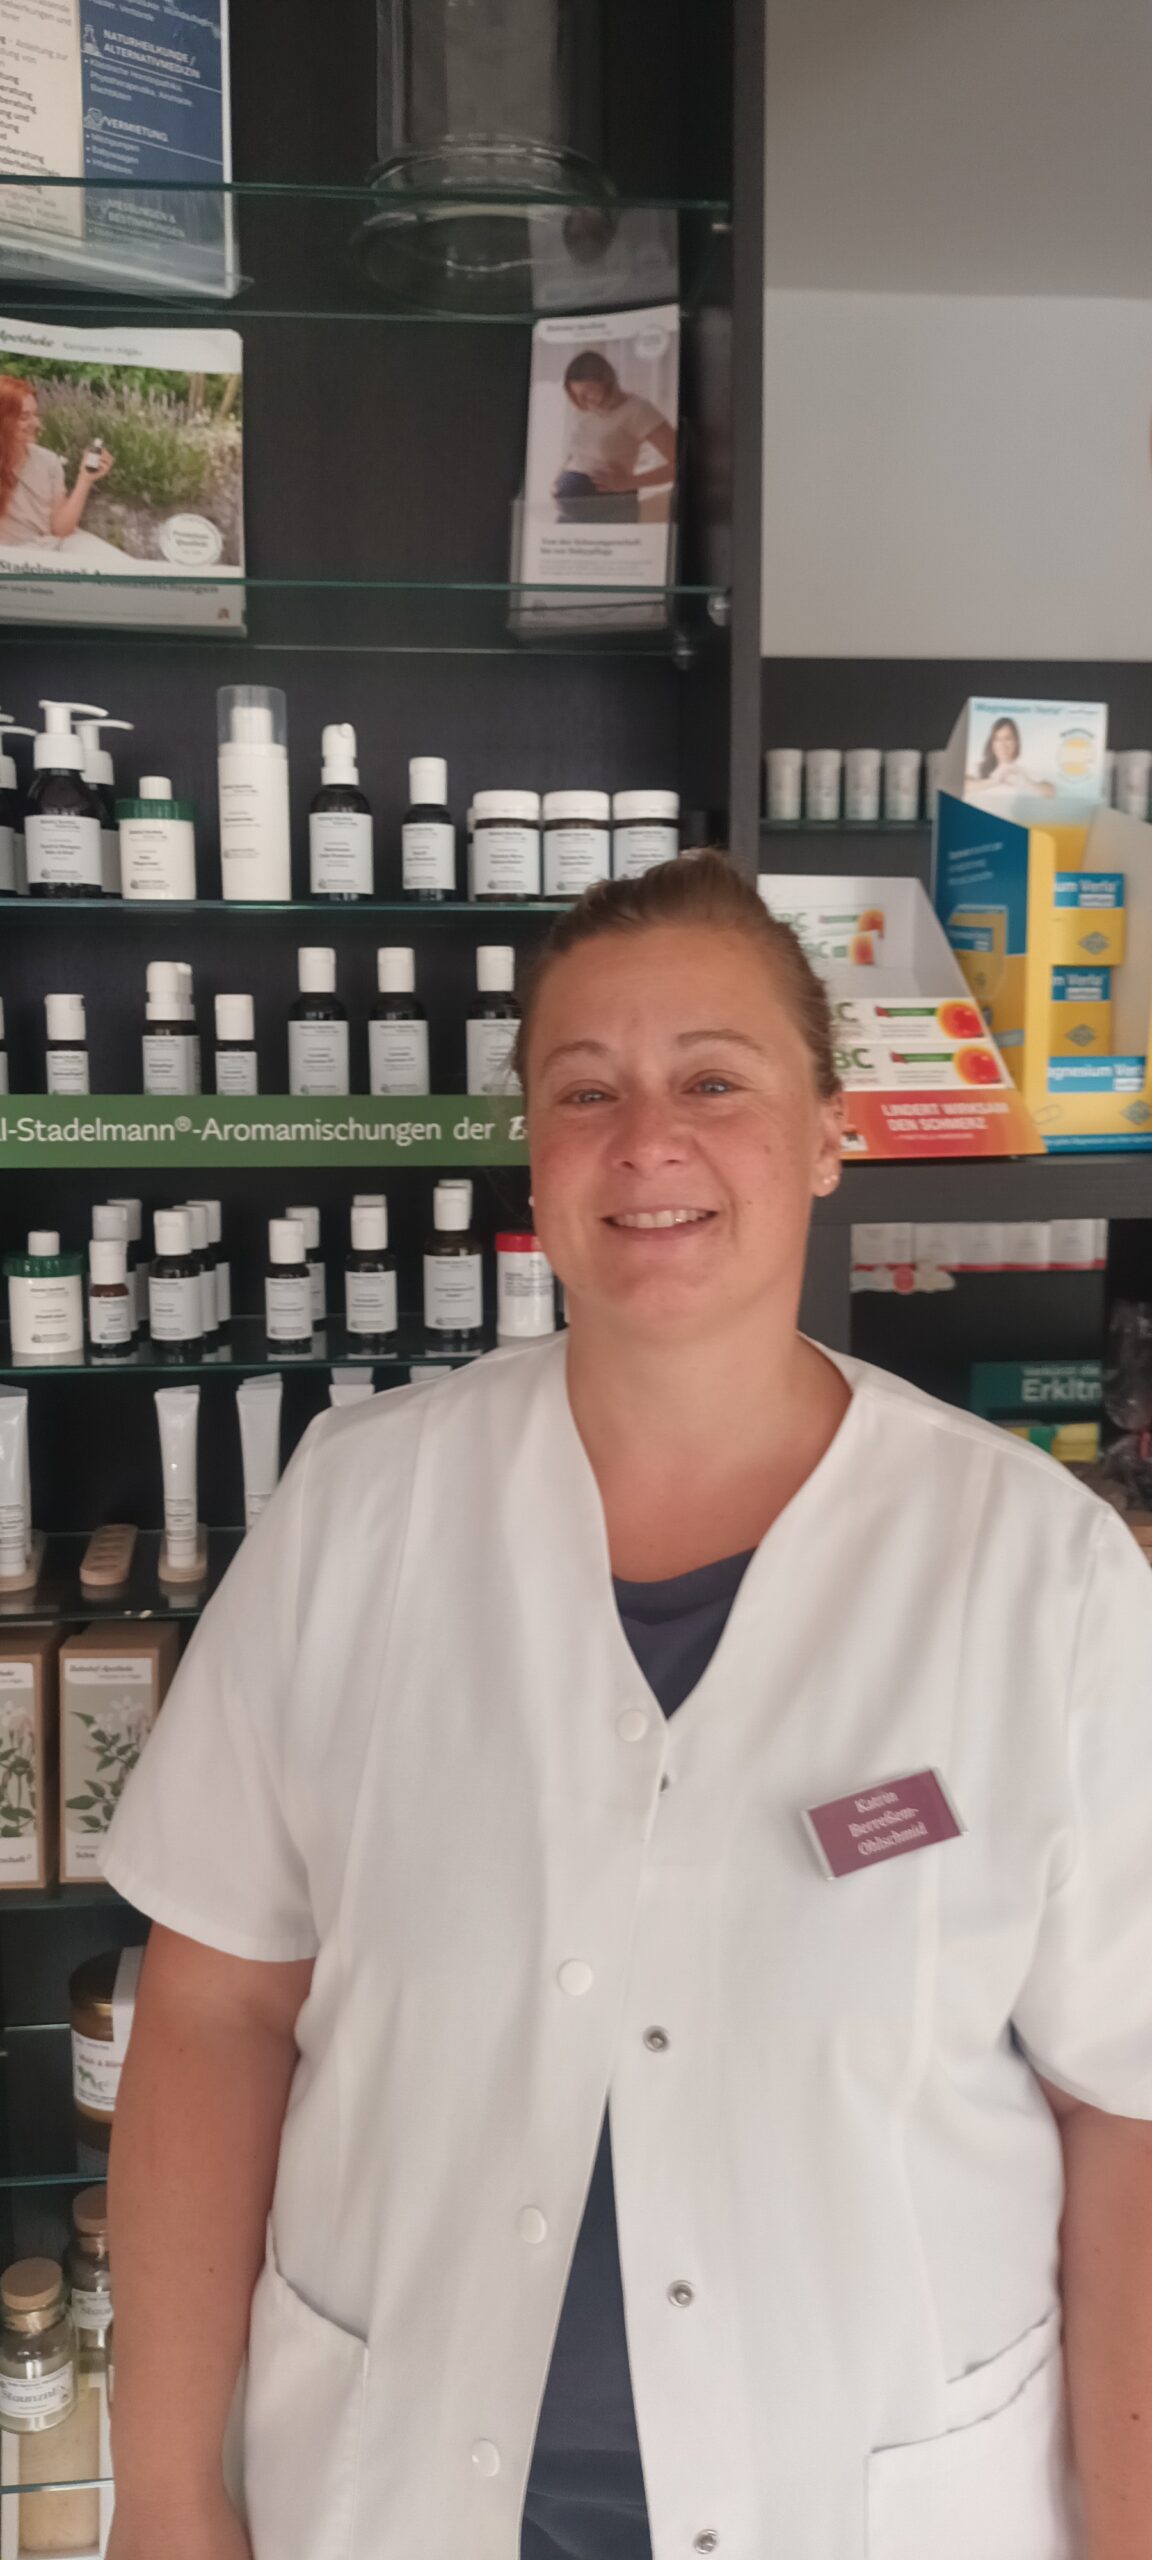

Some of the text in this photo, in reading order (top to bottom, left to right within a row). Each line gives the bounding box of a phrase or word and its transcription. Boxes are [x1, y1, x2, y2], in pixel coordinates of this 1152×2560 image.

[103, 29, 189, 63] NATURHEILKUNDE
[104, 43, 200, 78] ALTERNATIVMEDIZIN
[106, 117, 169, 142] VERMIETUNG
[880, 1101, 1010, 1117] LINDERT WIRKSAM
[0, 1114, 443, 1147] l-Stadelmann®-Aromamischungen
[453, 1117, 496, 1142] der
[887, 1117, 988, 1132] DEN SCHMERZ
[854, 1792, 899, 1813] Katrin
[848, 1807, 919, 1837] Berreßem-
[857, 1821, 928, 1855] Ohlschmid
